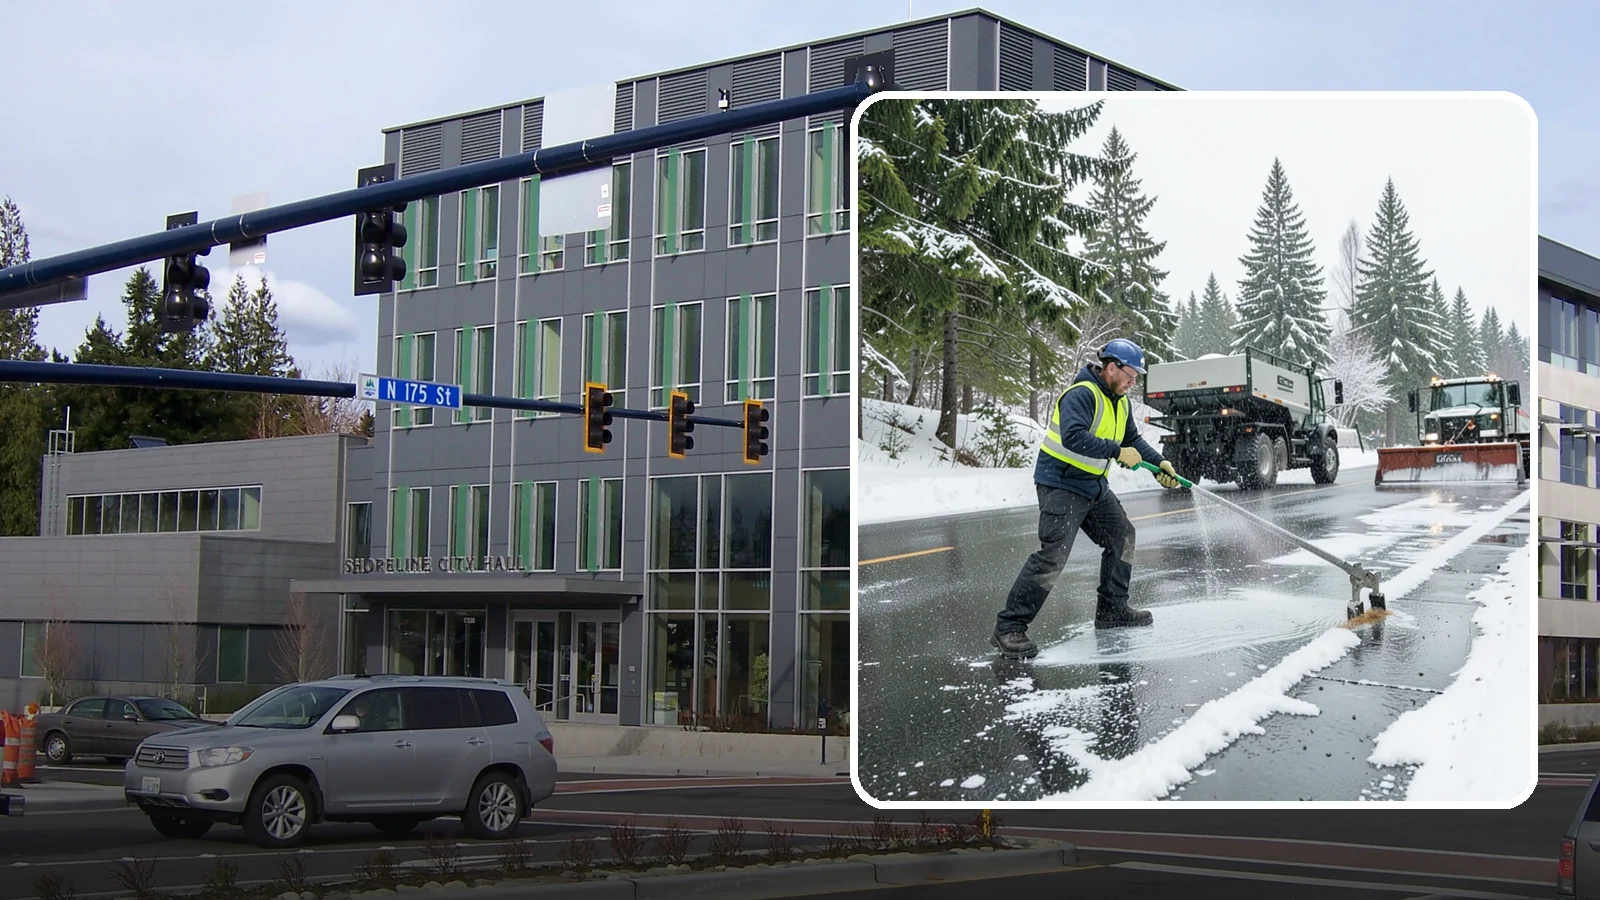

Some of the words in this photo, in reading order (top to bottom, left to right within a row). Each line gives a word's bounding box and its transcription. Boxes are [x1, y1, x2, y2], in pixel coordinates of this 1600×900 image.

[387, 380, 396, 400] N
[405, 382, 427, 403] 175
[436, 386, 451, 406] St
[344, 558, 432, 574] SHORELINE
[438, 556, 475, 572] CITY
[483, 555, 525, 571] HALL
